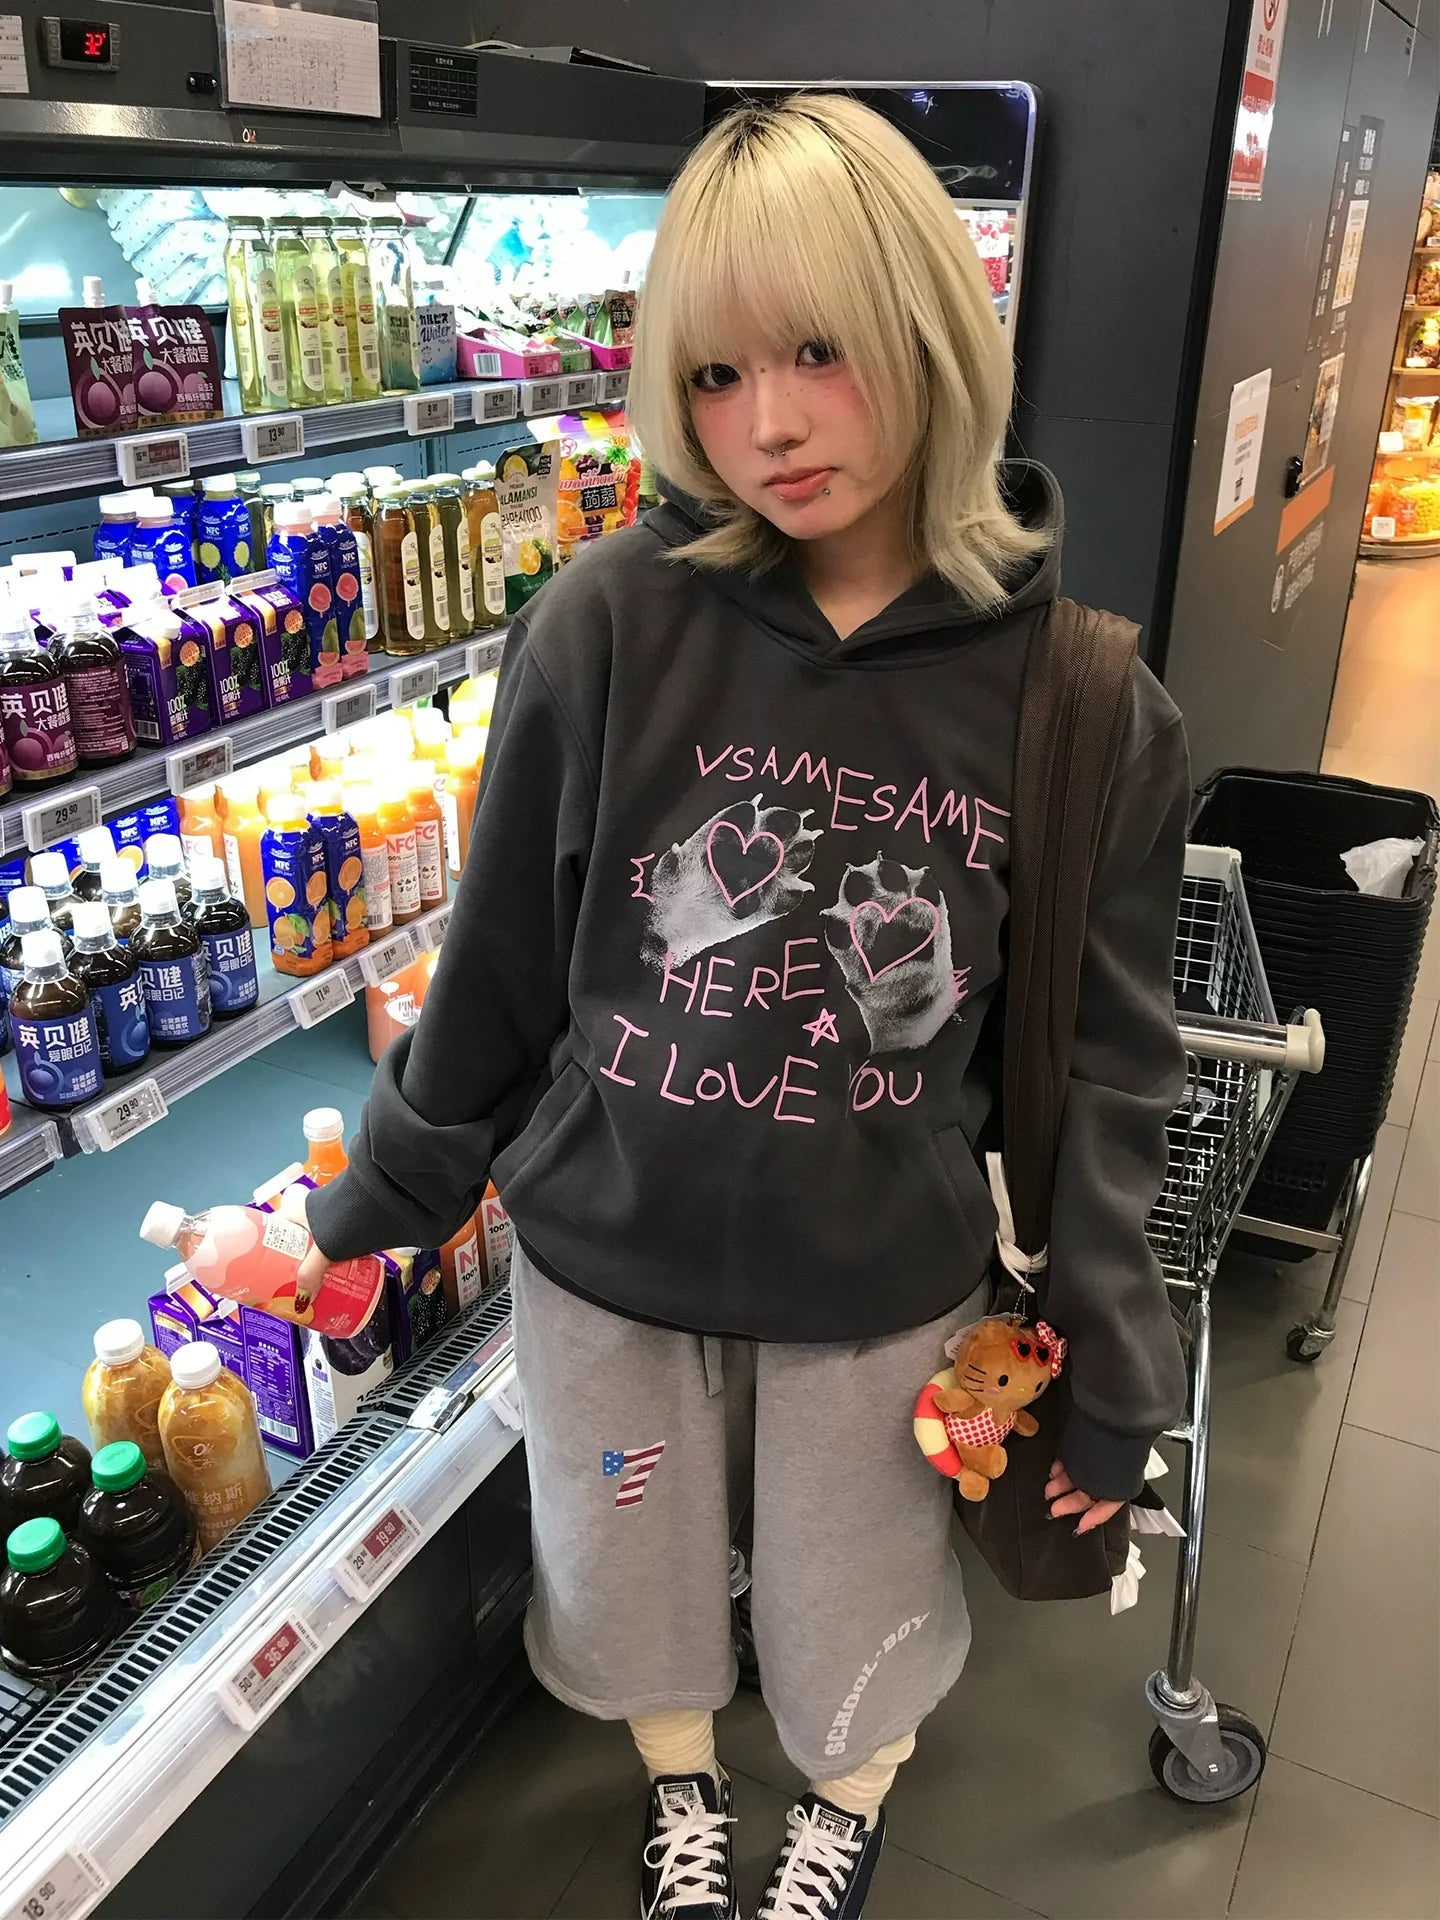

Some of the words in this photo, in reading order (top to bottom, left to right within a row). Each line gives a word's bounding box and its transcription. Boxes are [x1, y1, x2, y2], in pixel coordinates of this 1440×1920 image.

[160, 347, 210, 366] 大餐救星
[500, 486, 538, 506] ALAMANSI
[583, 487, 616, 510] 蒟蒻
[206, 526, 220, 536] NFC
[239, 523, 249, 533] NFC
[169, 553, 183, 565] NFC
[342, 552, 356, 563] NFC
[276, 564, 291, 575] NFC
[314, 561, 328, 573] NFC
[0, 682, 70, 720] 英贝健
[695, 744, 1012, 870] VSAMESAME
[149, 815, 168, 827] NFC
[120, 827, 138, 839] NFC
[415, 824, 437, 841] FC
[345, 837, 358, 850] NFC
[274, 859, 290, 871] NFC
[311, 852, 325, 865] NFC
[219, 951, 254, 973] 爱眼日记
[141, 965, 183, 989] 贝健
[658, 937, 825, 1019] HERE
[18, 1017, 91, 1050] 英贝健
[49, 1038, 93, 1063] 爱眼日记
[599, 1015, 650, 1087] I
[659, 1043, 819, 1124] LOVE
[848, 1058, 922, 1113] OU
[489, 1221, 510, 1234] 100%
[458, 1241, 478, 1274] NF
[663, 1784, 693, 1795] CONVERSE
[819, 1809, 850, 1828] CONVERSE
[816, 1817, 827, 1830] ALL
[832, 1825, 849, 1840] STAR
